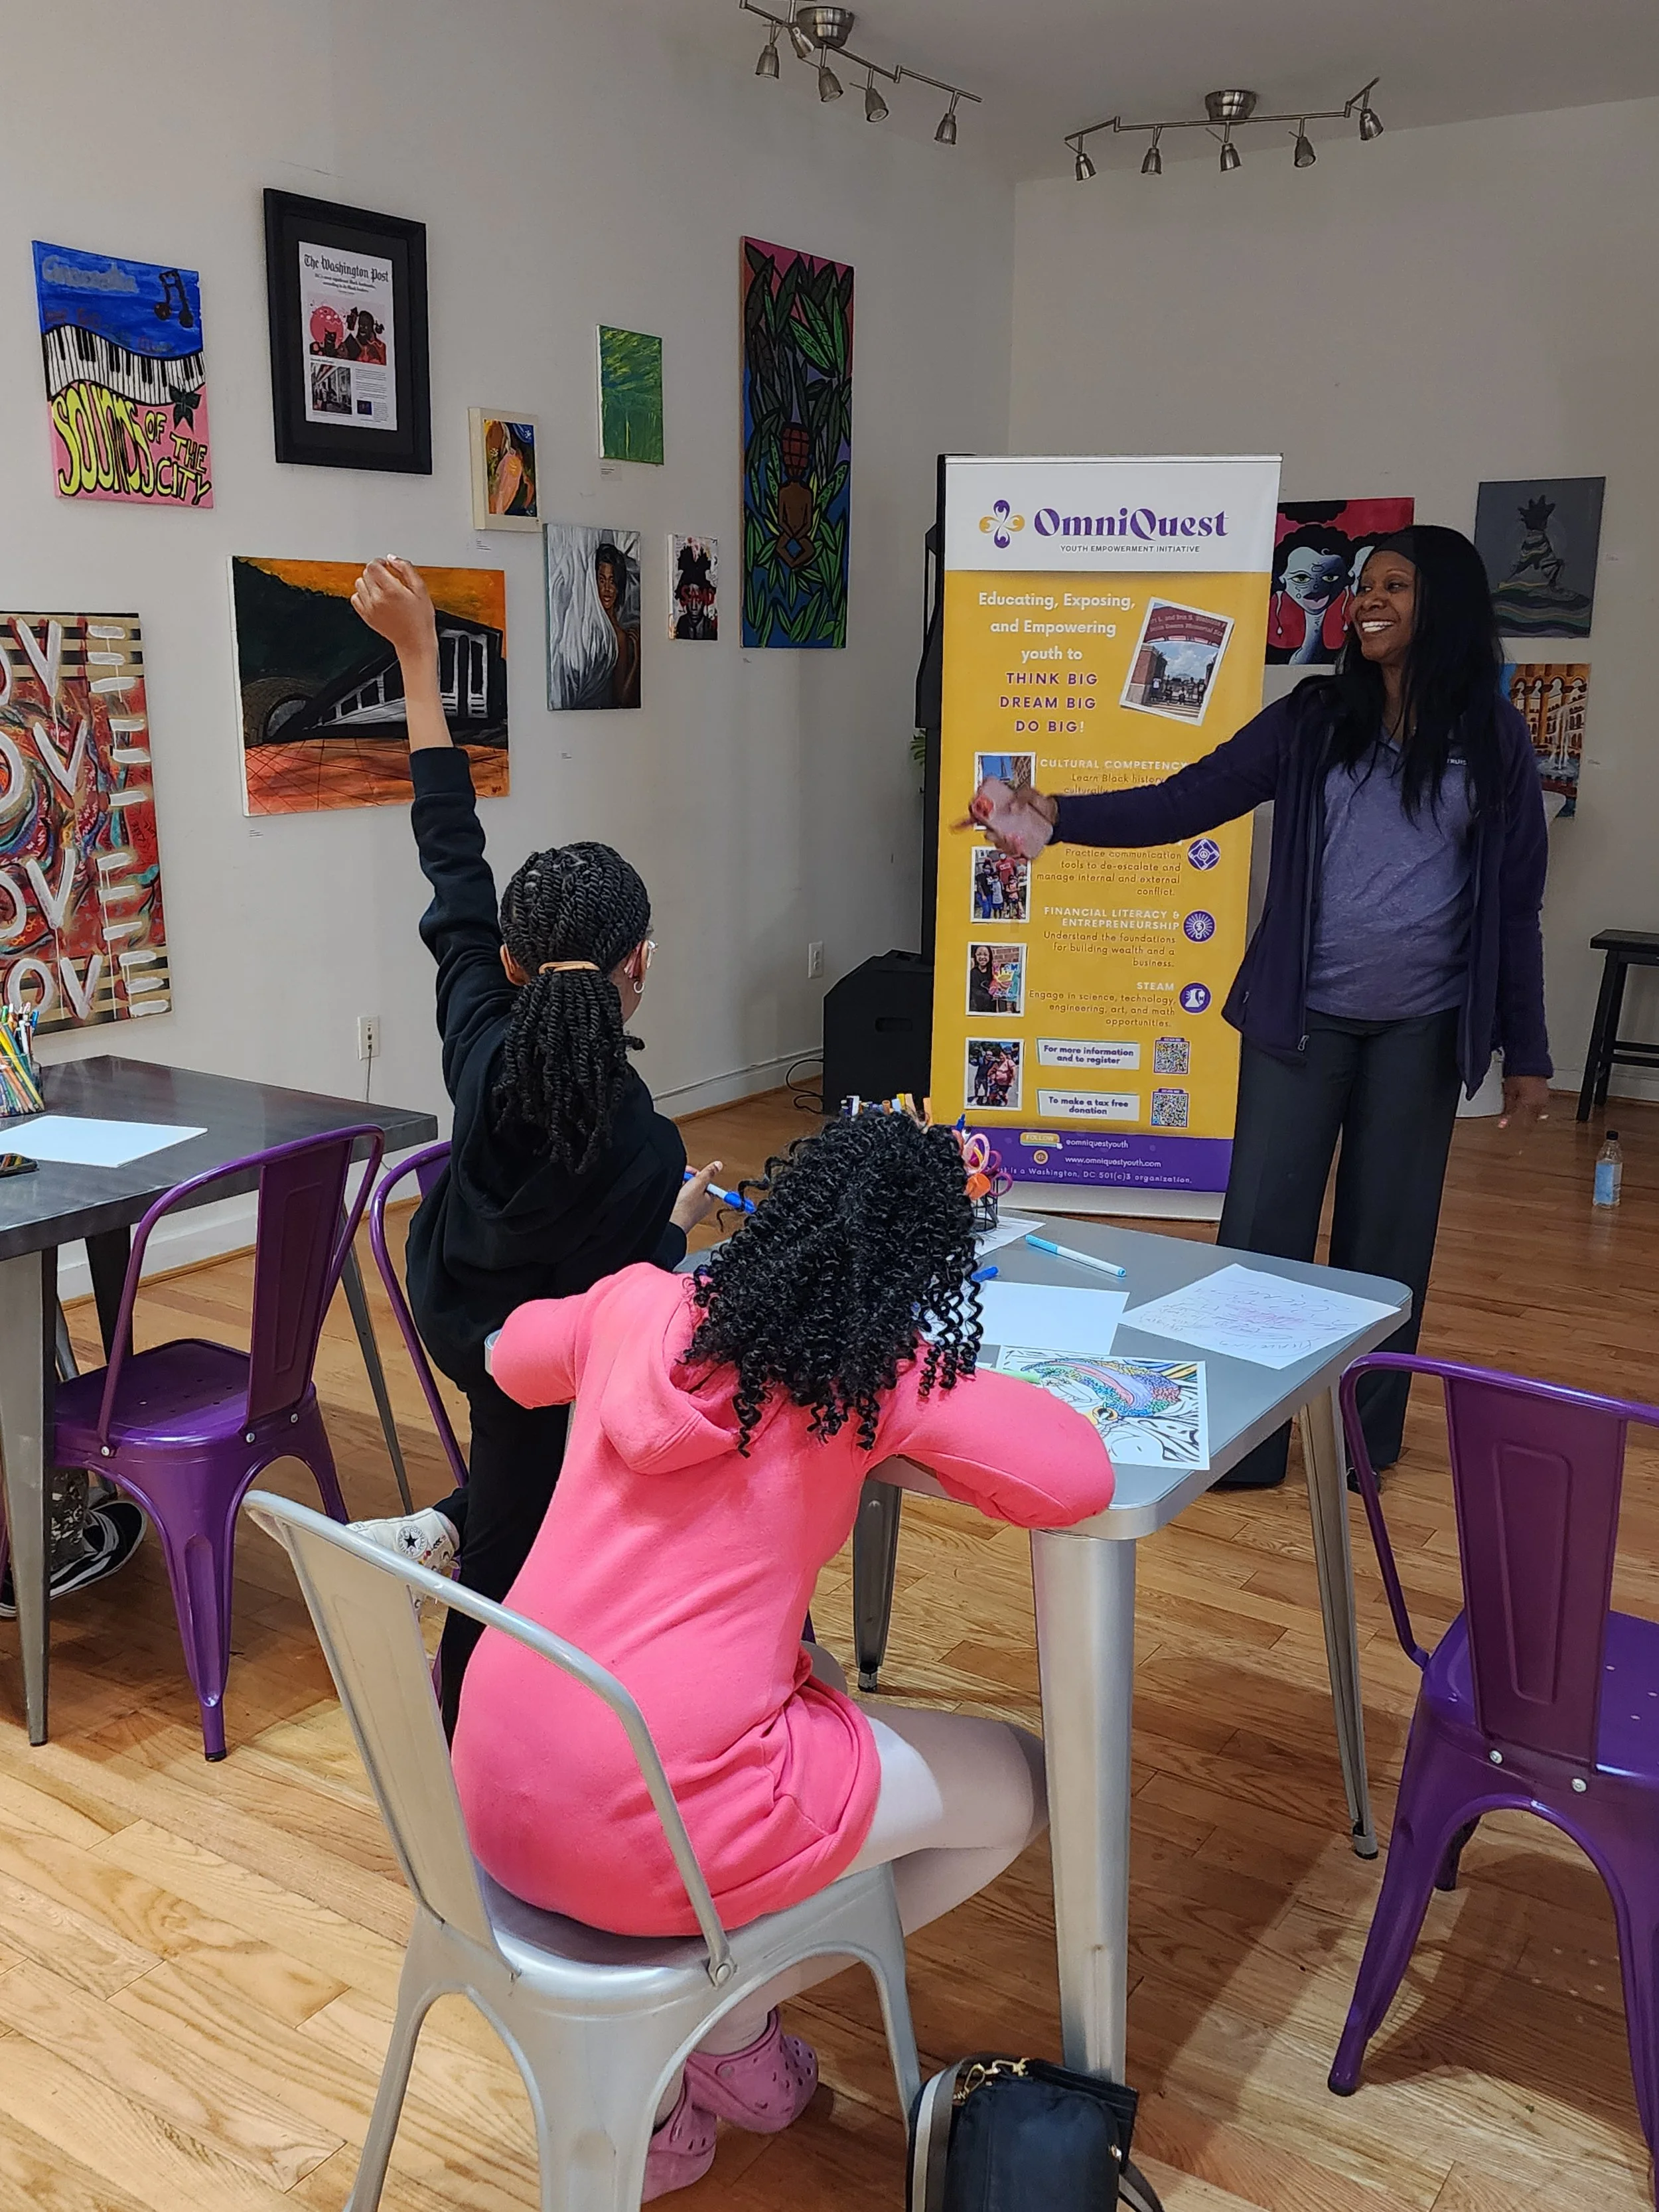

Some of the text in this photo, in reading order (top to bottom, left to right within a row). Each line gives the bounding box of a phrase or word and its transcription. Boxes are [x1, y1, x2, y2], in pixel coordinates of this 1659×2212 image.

[305, 254, 319, 270] The
[321, 255, 369, 279] Washington
[371, 267, 389, 283] Post
[145, 410, 166, 443] OF
[52, 380, 155, 496] SOUNDS
[170, 433, 207, 474] THE
[156, 456, 212, 506] CITY
[1034, 508, 1228, 541] OmniQuest
[979, 592, 1135, 611] Educating, Exposing,
[991, 620, 1116, 637] and Empowering
[0, 618, 135, 705] VE
[1021, 647, 1083, 664] youth to
[1007, 673, 1098, 685] THINK BIG
[1000, 697, 1096, 709] DREAM BIG
[1016, 721, 1084, 733] DO BIG!
[1041, 759, 1100, 769] CULTURAL
[1072, 774, 1098, 782] Learn
[1066, 848, 1181, 860] Practice communication
[1061, 861, 1181, 872] tools to de-escalate and
[1037, 873, 1180, 885] manage internal and external
[1137, 886, 1175, 896] conflict.
[1044, 907, 1108, 917] FINANCIAL
[1112, 909, 1168, 919] LITERACY
[1062, 919, 1179, 930] ENTREPRENEURSHIP
[1044, 931, 1176, 944] Understand the foundations
[1053, 942, 1067, 952] for
[1070, 943, 1108, 955] building
[1111, 945, 1143, 954] wealth
[1147, 946, 1165, 956] and
[1133, 958, 1175, 968] business.
[1137, 982, 1175, 991] STEAM
[1029, 990, 1064, 1001] Engage
[1080, 993, 1118, 1003] science,
[1121, 994, 1176, 1006] technology,
[1050, 1003, 1175, 1015] engineering, art, and math
[1106, 1017, 1172, 1027] opportunities.
[1044, 1045, 1058, 1054] For
[1083, 1047, 1133, 1057] information
[1057, 1054, 1120, 1066] and to register
[1048, 1096, 1059, 1104] To
[1061, 1096, 1085, 1106] make
[1095, 1098, 1108, 1107] tax
[1111, 1098, 1128, 1108] free
[1069, 1106, 1108, 1115] donation
[1066, 1140, 1128, 1149] @omniquestyouth
[1065, 1157, 1161, 1168] www.omniquestyouth.com
[1099, 1171, 1131, 1181] 501(c)3
[1135, 1175, 1192, 1184] organization.
